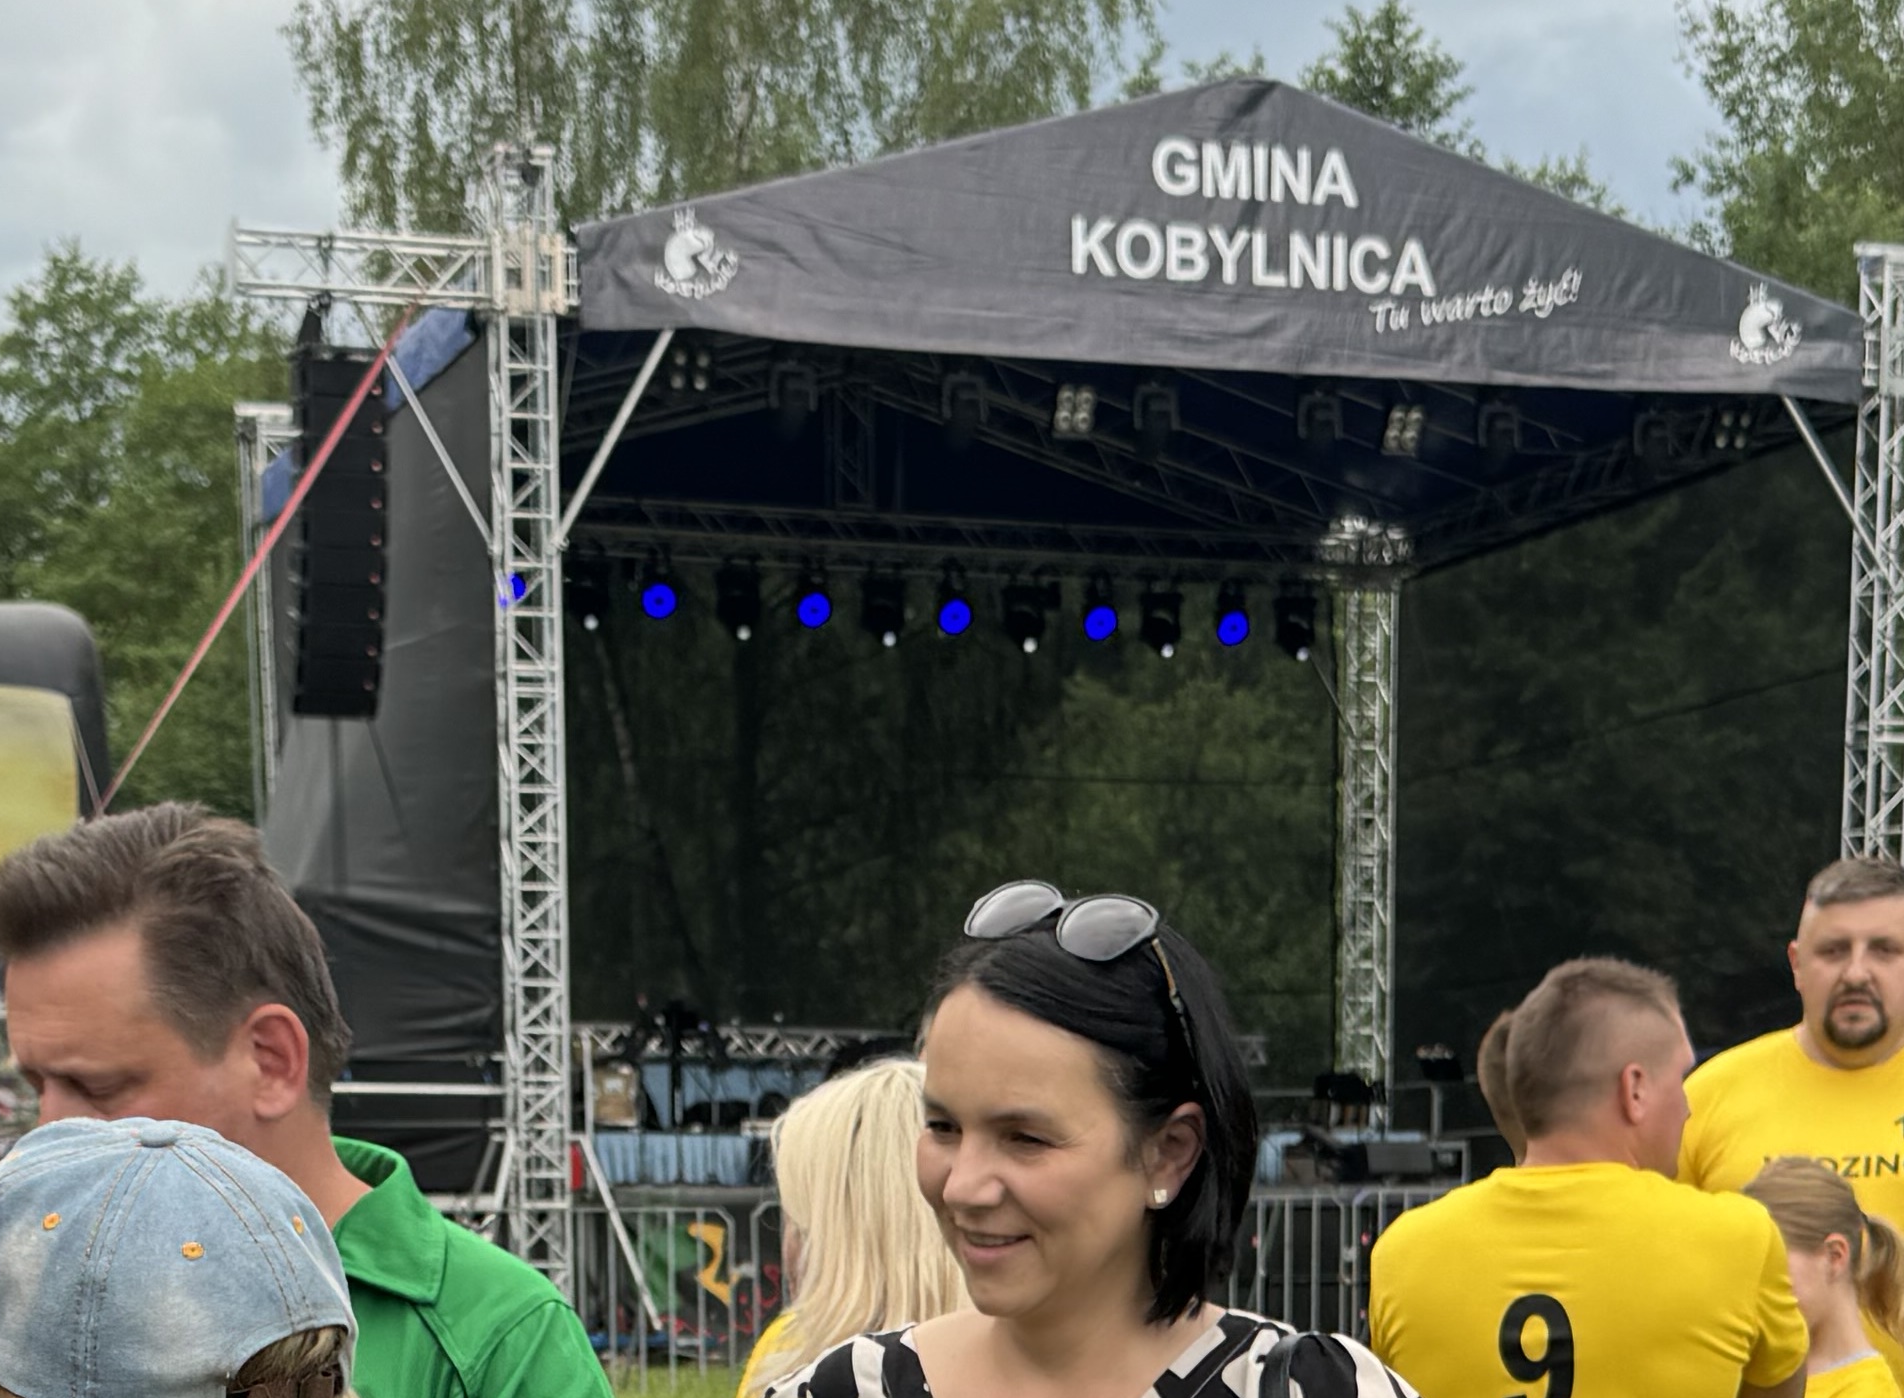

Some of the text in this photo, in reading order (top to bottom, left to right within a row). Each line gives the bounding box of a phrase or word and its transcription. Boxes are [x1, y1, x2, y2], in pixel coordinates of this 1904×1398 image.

[1152, 136, 1359, 208] GMINA
[1071, 213, 1437, 297] KOBYLNICA
[1369, 265, 1583, 333] Tu warto żyć!
